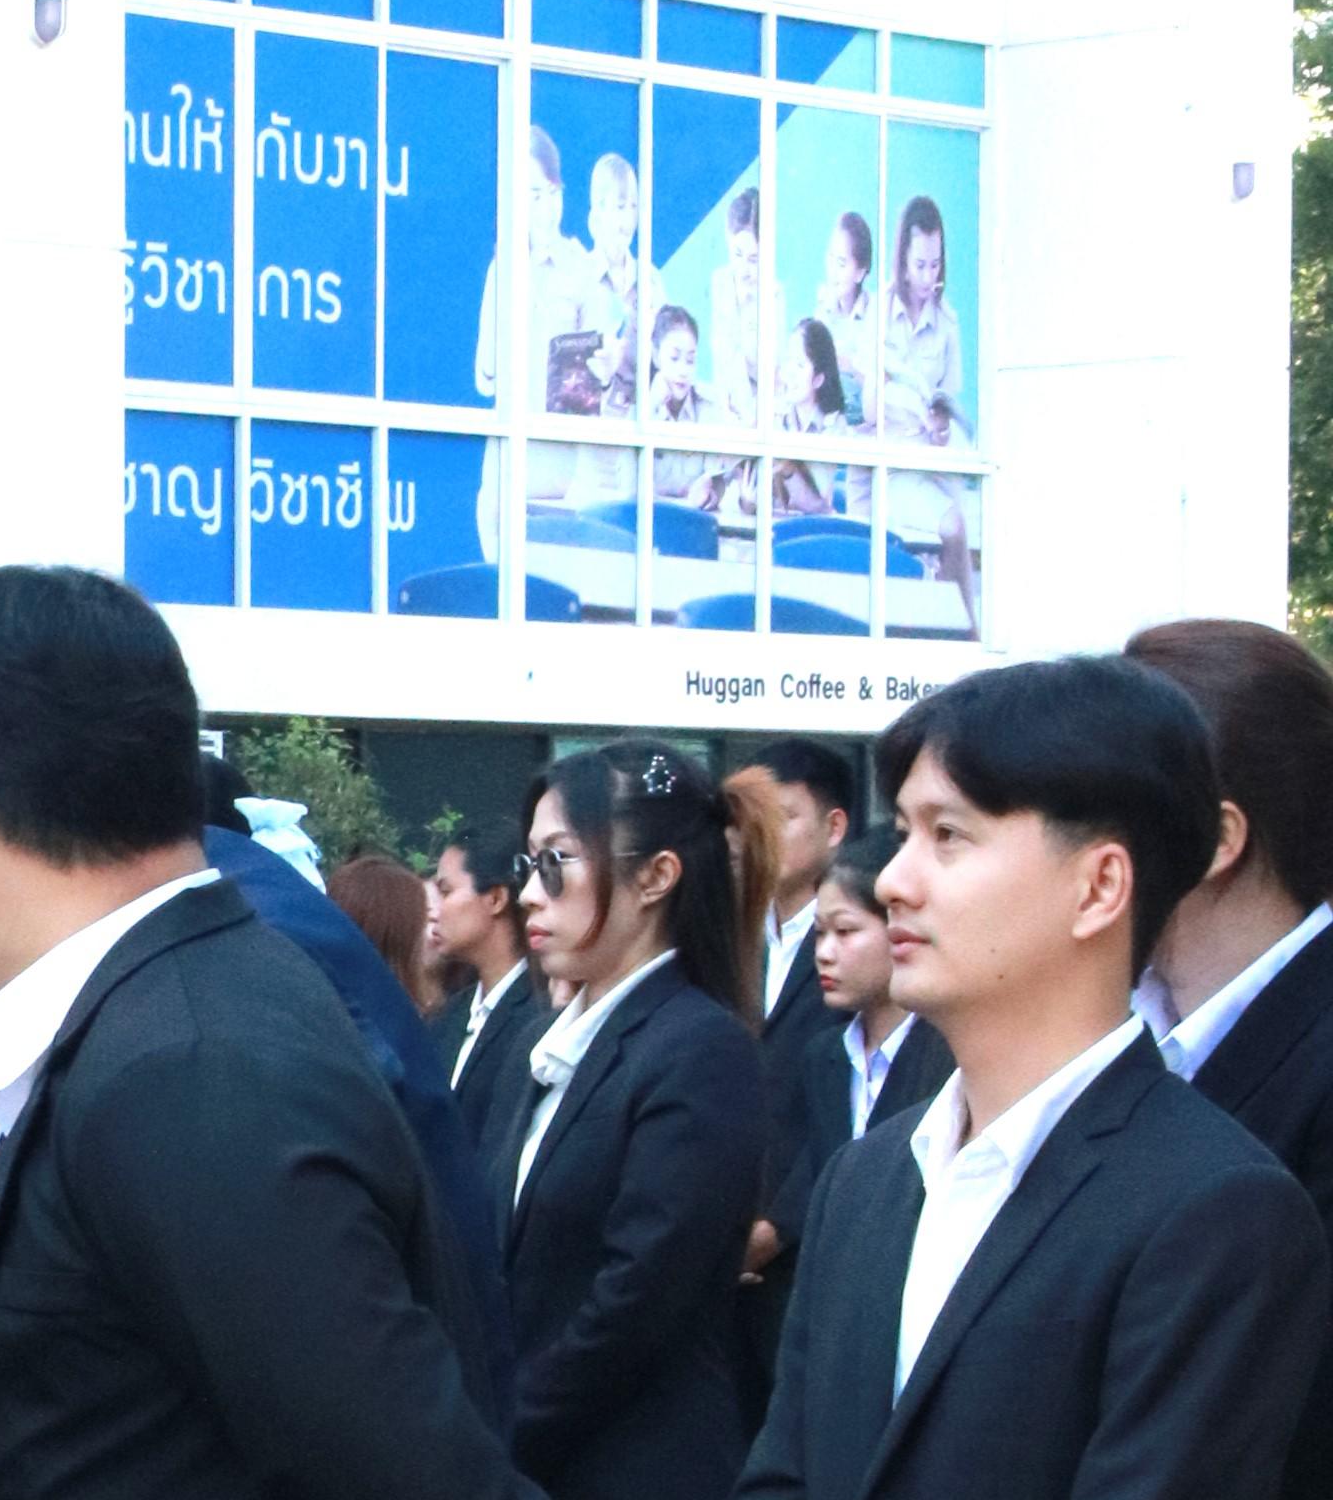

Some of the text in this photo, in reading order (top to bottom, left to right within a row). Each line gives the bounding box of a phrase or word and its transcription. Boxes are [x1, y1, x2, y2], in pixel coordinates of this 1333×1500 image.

[686, 670, 765, 704] Huggan
[780, 672, 845, 700] Coffee
[858, 675, 874, 701] &
